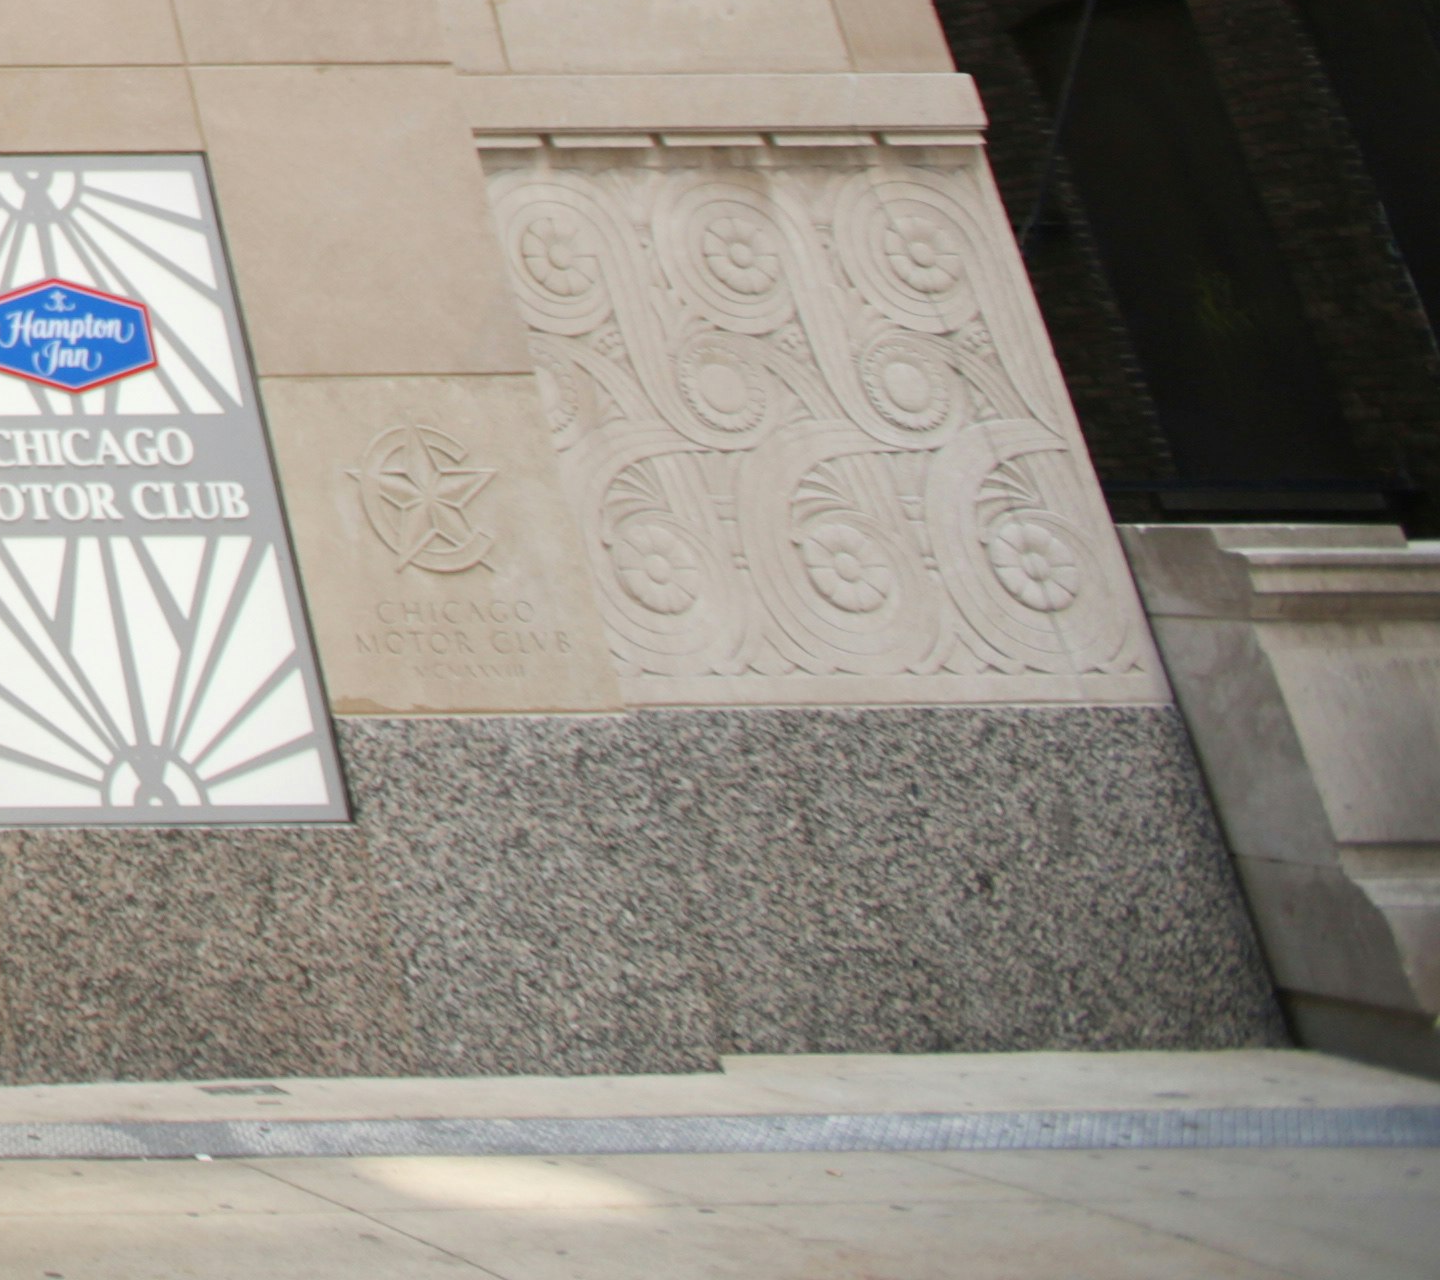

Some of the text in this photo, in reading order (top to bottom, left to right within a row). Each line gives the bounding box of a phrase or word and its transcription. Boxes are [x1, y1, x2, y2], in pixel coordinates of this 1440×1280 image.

[32, 340, 102, 377] Inn
[131, 481, 250, 520] CLUB
[377, 600, 535, 625] CHICAGO
[354, 630, 477, 655] MOTOR
